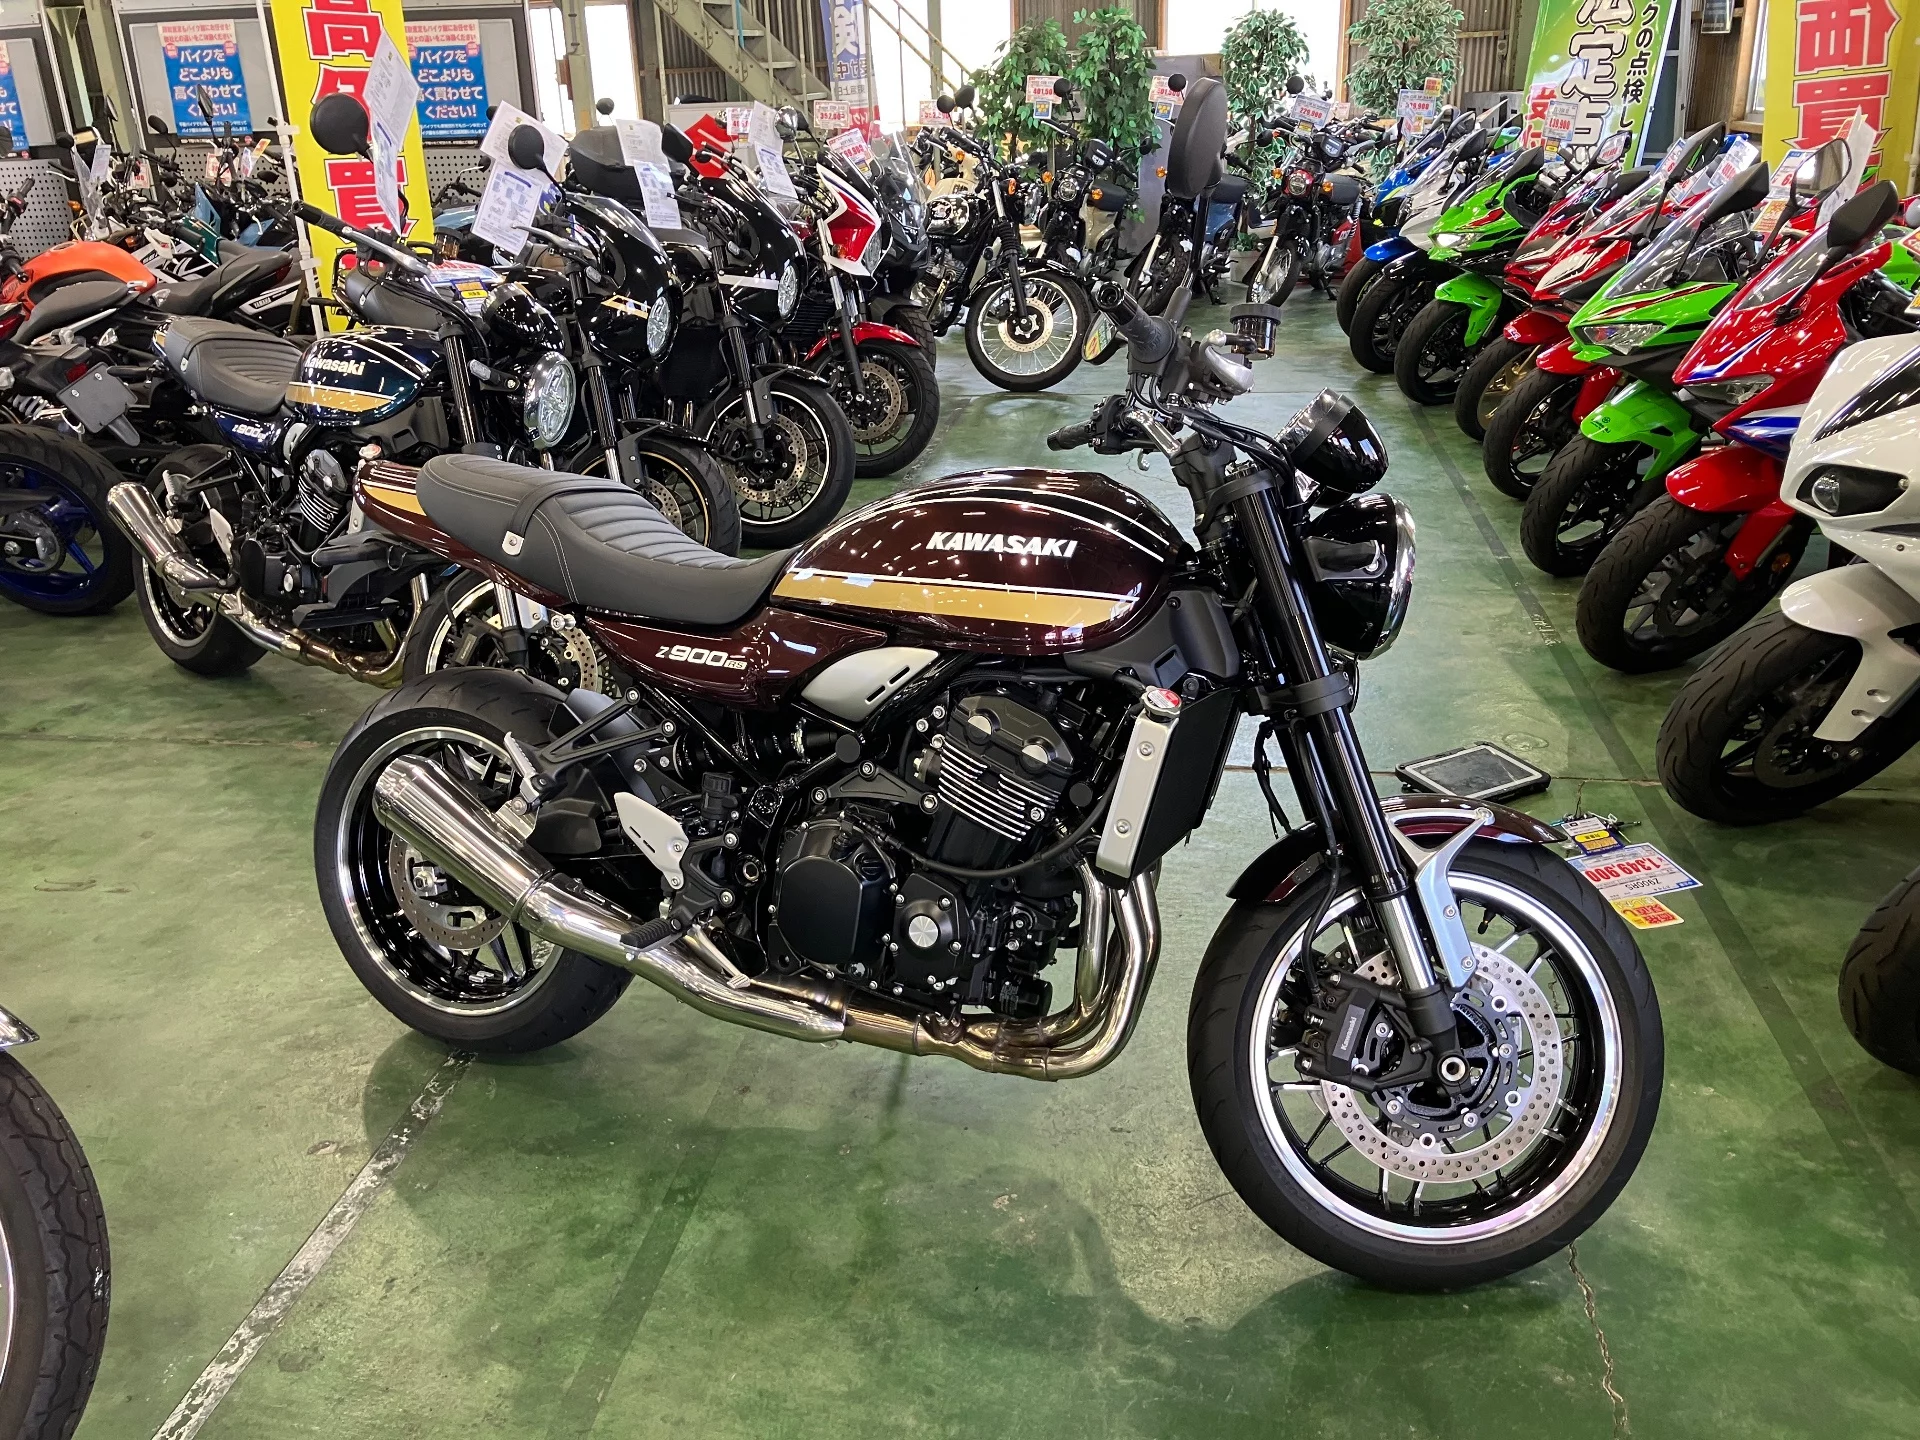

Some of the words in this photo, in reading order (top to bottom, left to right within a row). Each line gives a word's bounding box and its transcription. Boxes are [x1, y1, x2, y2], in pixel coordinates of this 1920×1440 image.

[180, 49, 225, 63] バイクを
[420, 50, 467, 64] バイクを
[179, 66, 233, 81] どこよりも
[418, 68, 475, 82] どこよりも
[173, 84, 242, 100] 高くわせて
[425, 104, 476, 118] ください!
[304, 355, 366, 376] Kawasaki
[926, 531, 1079, 558] KAWASAKI
[1585, 857, 1661, 882] 1,349,900
[1625, 878, 1661, 891] Z900RS
[1340, 1016, 1357, 1051] Kawasaki
